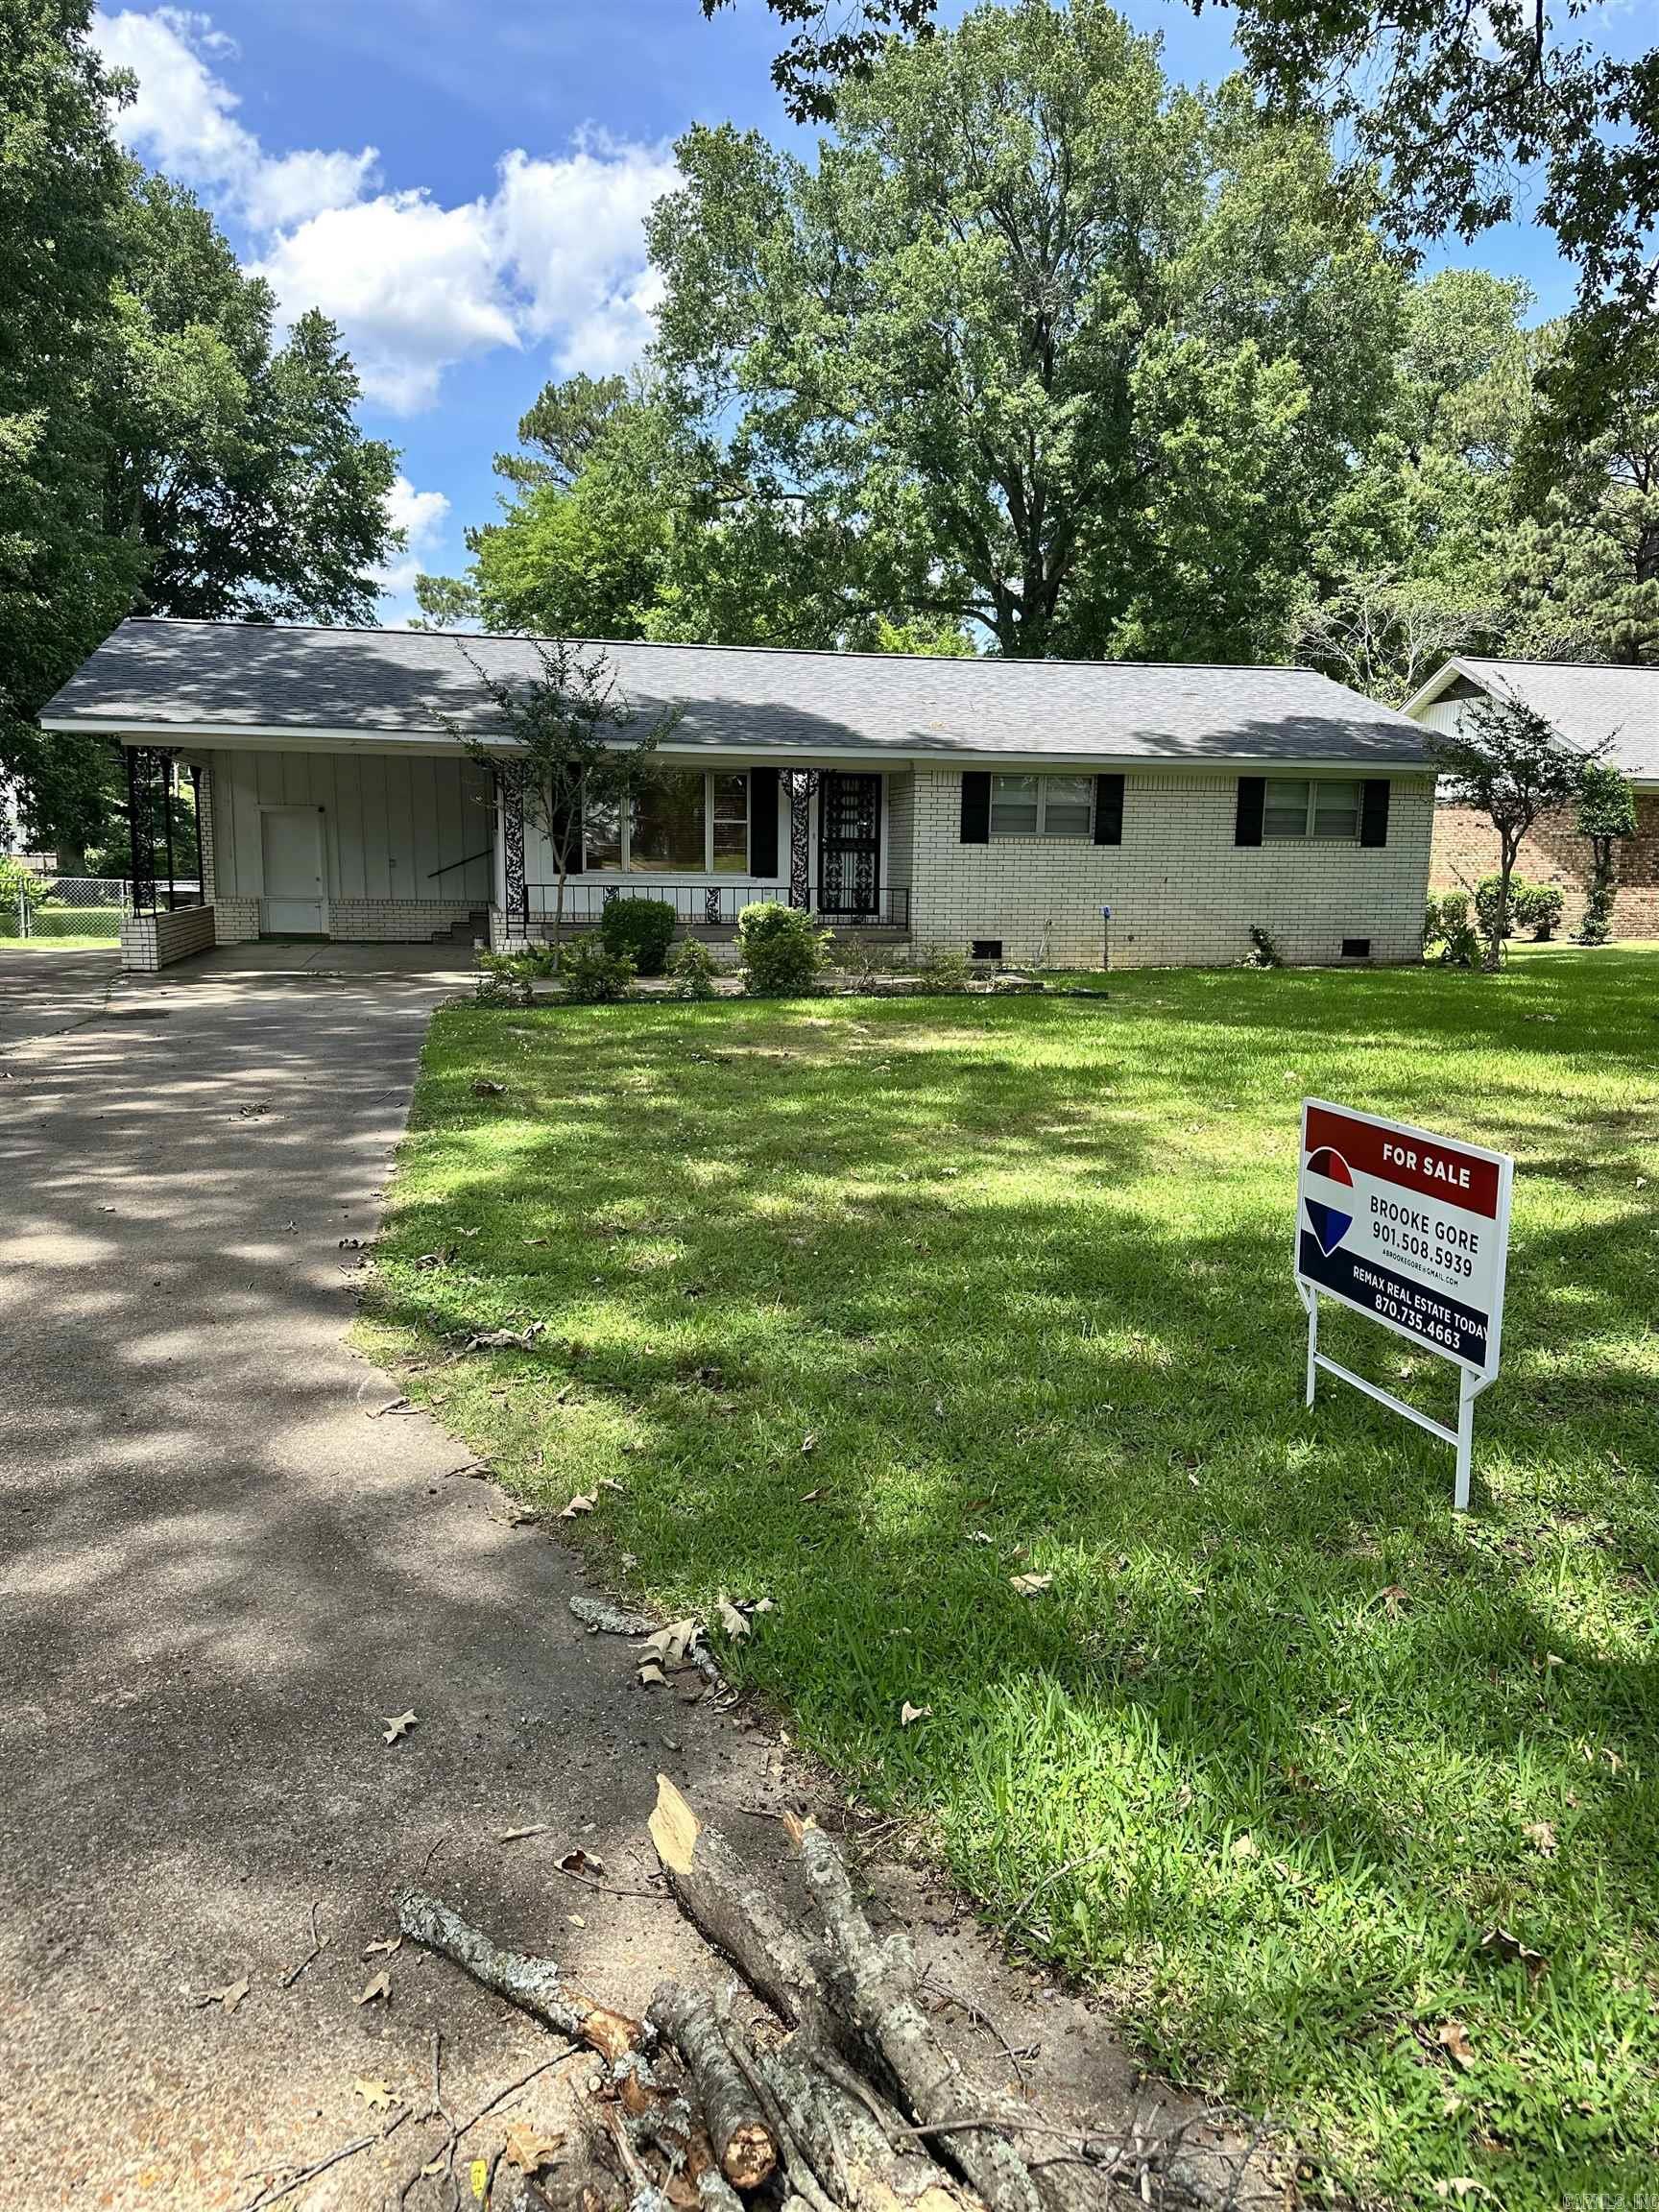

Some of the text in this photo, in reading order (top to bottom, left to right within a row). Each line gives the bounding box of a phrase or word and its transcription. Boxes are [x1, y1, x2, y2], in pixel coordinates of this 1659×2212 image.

[1383, 1143, 1471, 1189] FOR SALE
[1370, 1195, 1479, 1254] BROOKE GORE
[1373, 1221, 1473, 1277] 901.508.5939
[1353, 1265, 1385, 1291] REMAX
[1386, 1282, 1412, 1305] REAL
[1414, 1295, 1452, 1323] ESTATE
[1375, 1294, 1460, 1349] 870.735.4663
